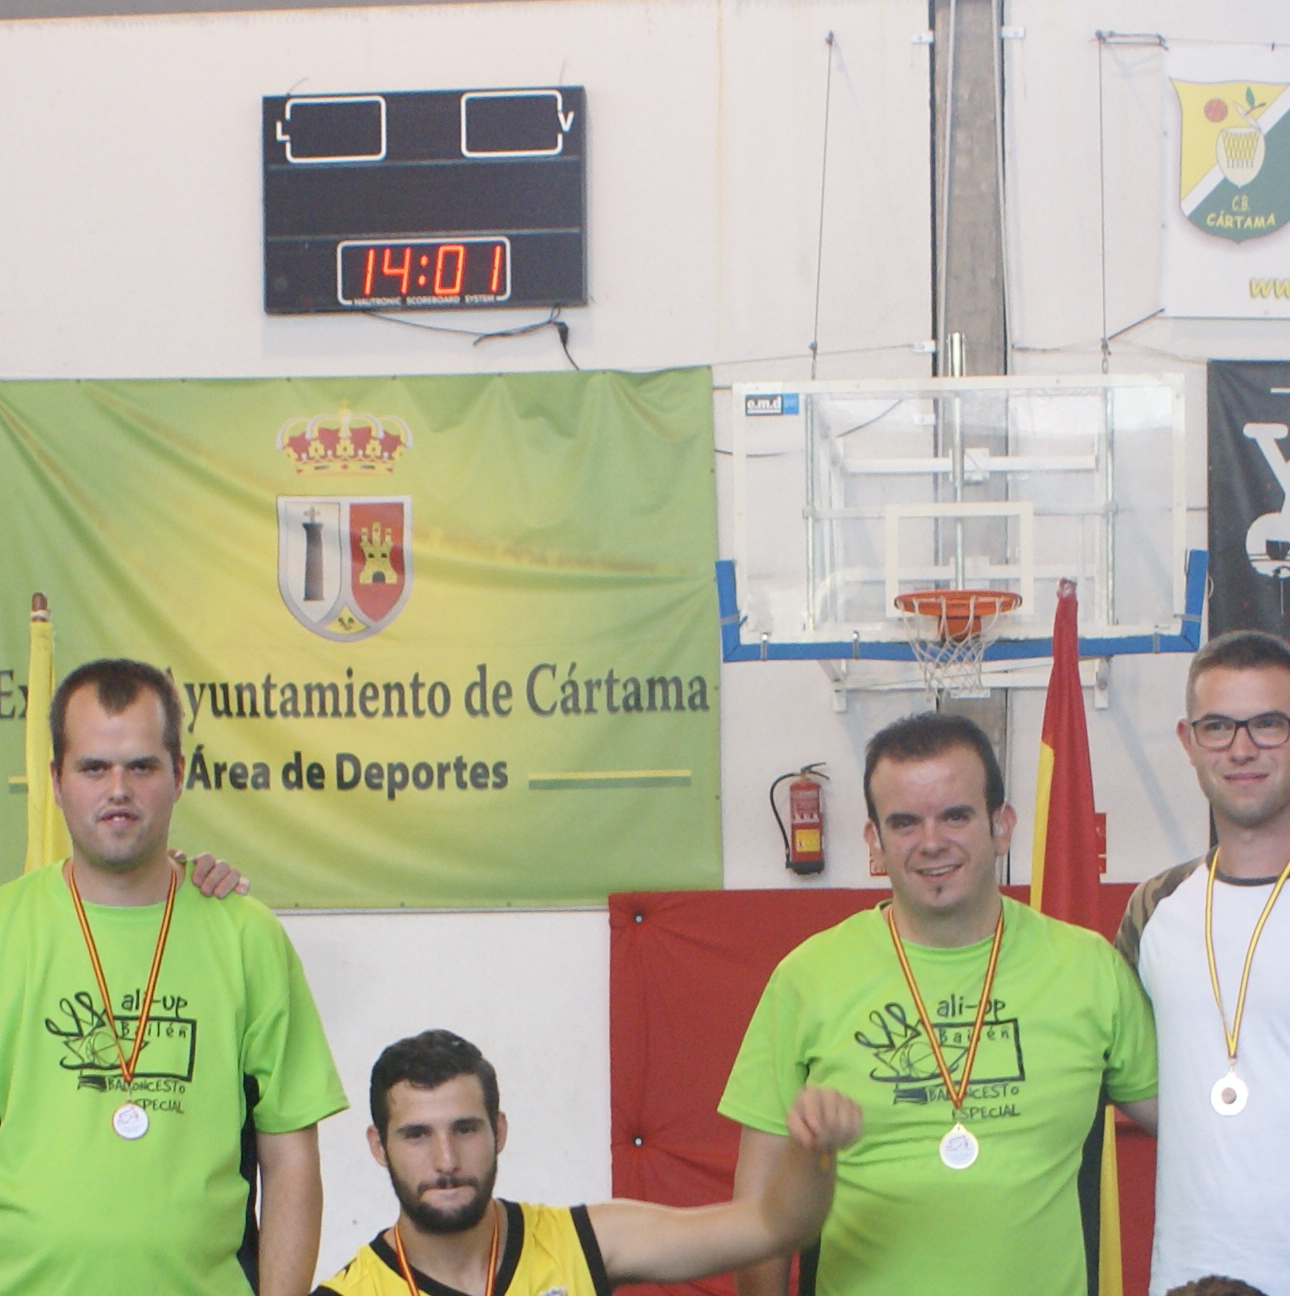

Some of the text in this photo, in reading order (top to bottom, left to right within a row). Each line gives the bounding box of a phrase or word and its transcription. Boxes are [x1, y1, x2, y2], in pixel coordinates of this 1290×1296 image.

[1206, 210, 1276, 230] CÁRTAMA
[363, 244, 502, 296] 14:01
[165, 661, 710, 733] yuntamiento de Cártama
[184, 750, 509, 800] Área de Deportes
